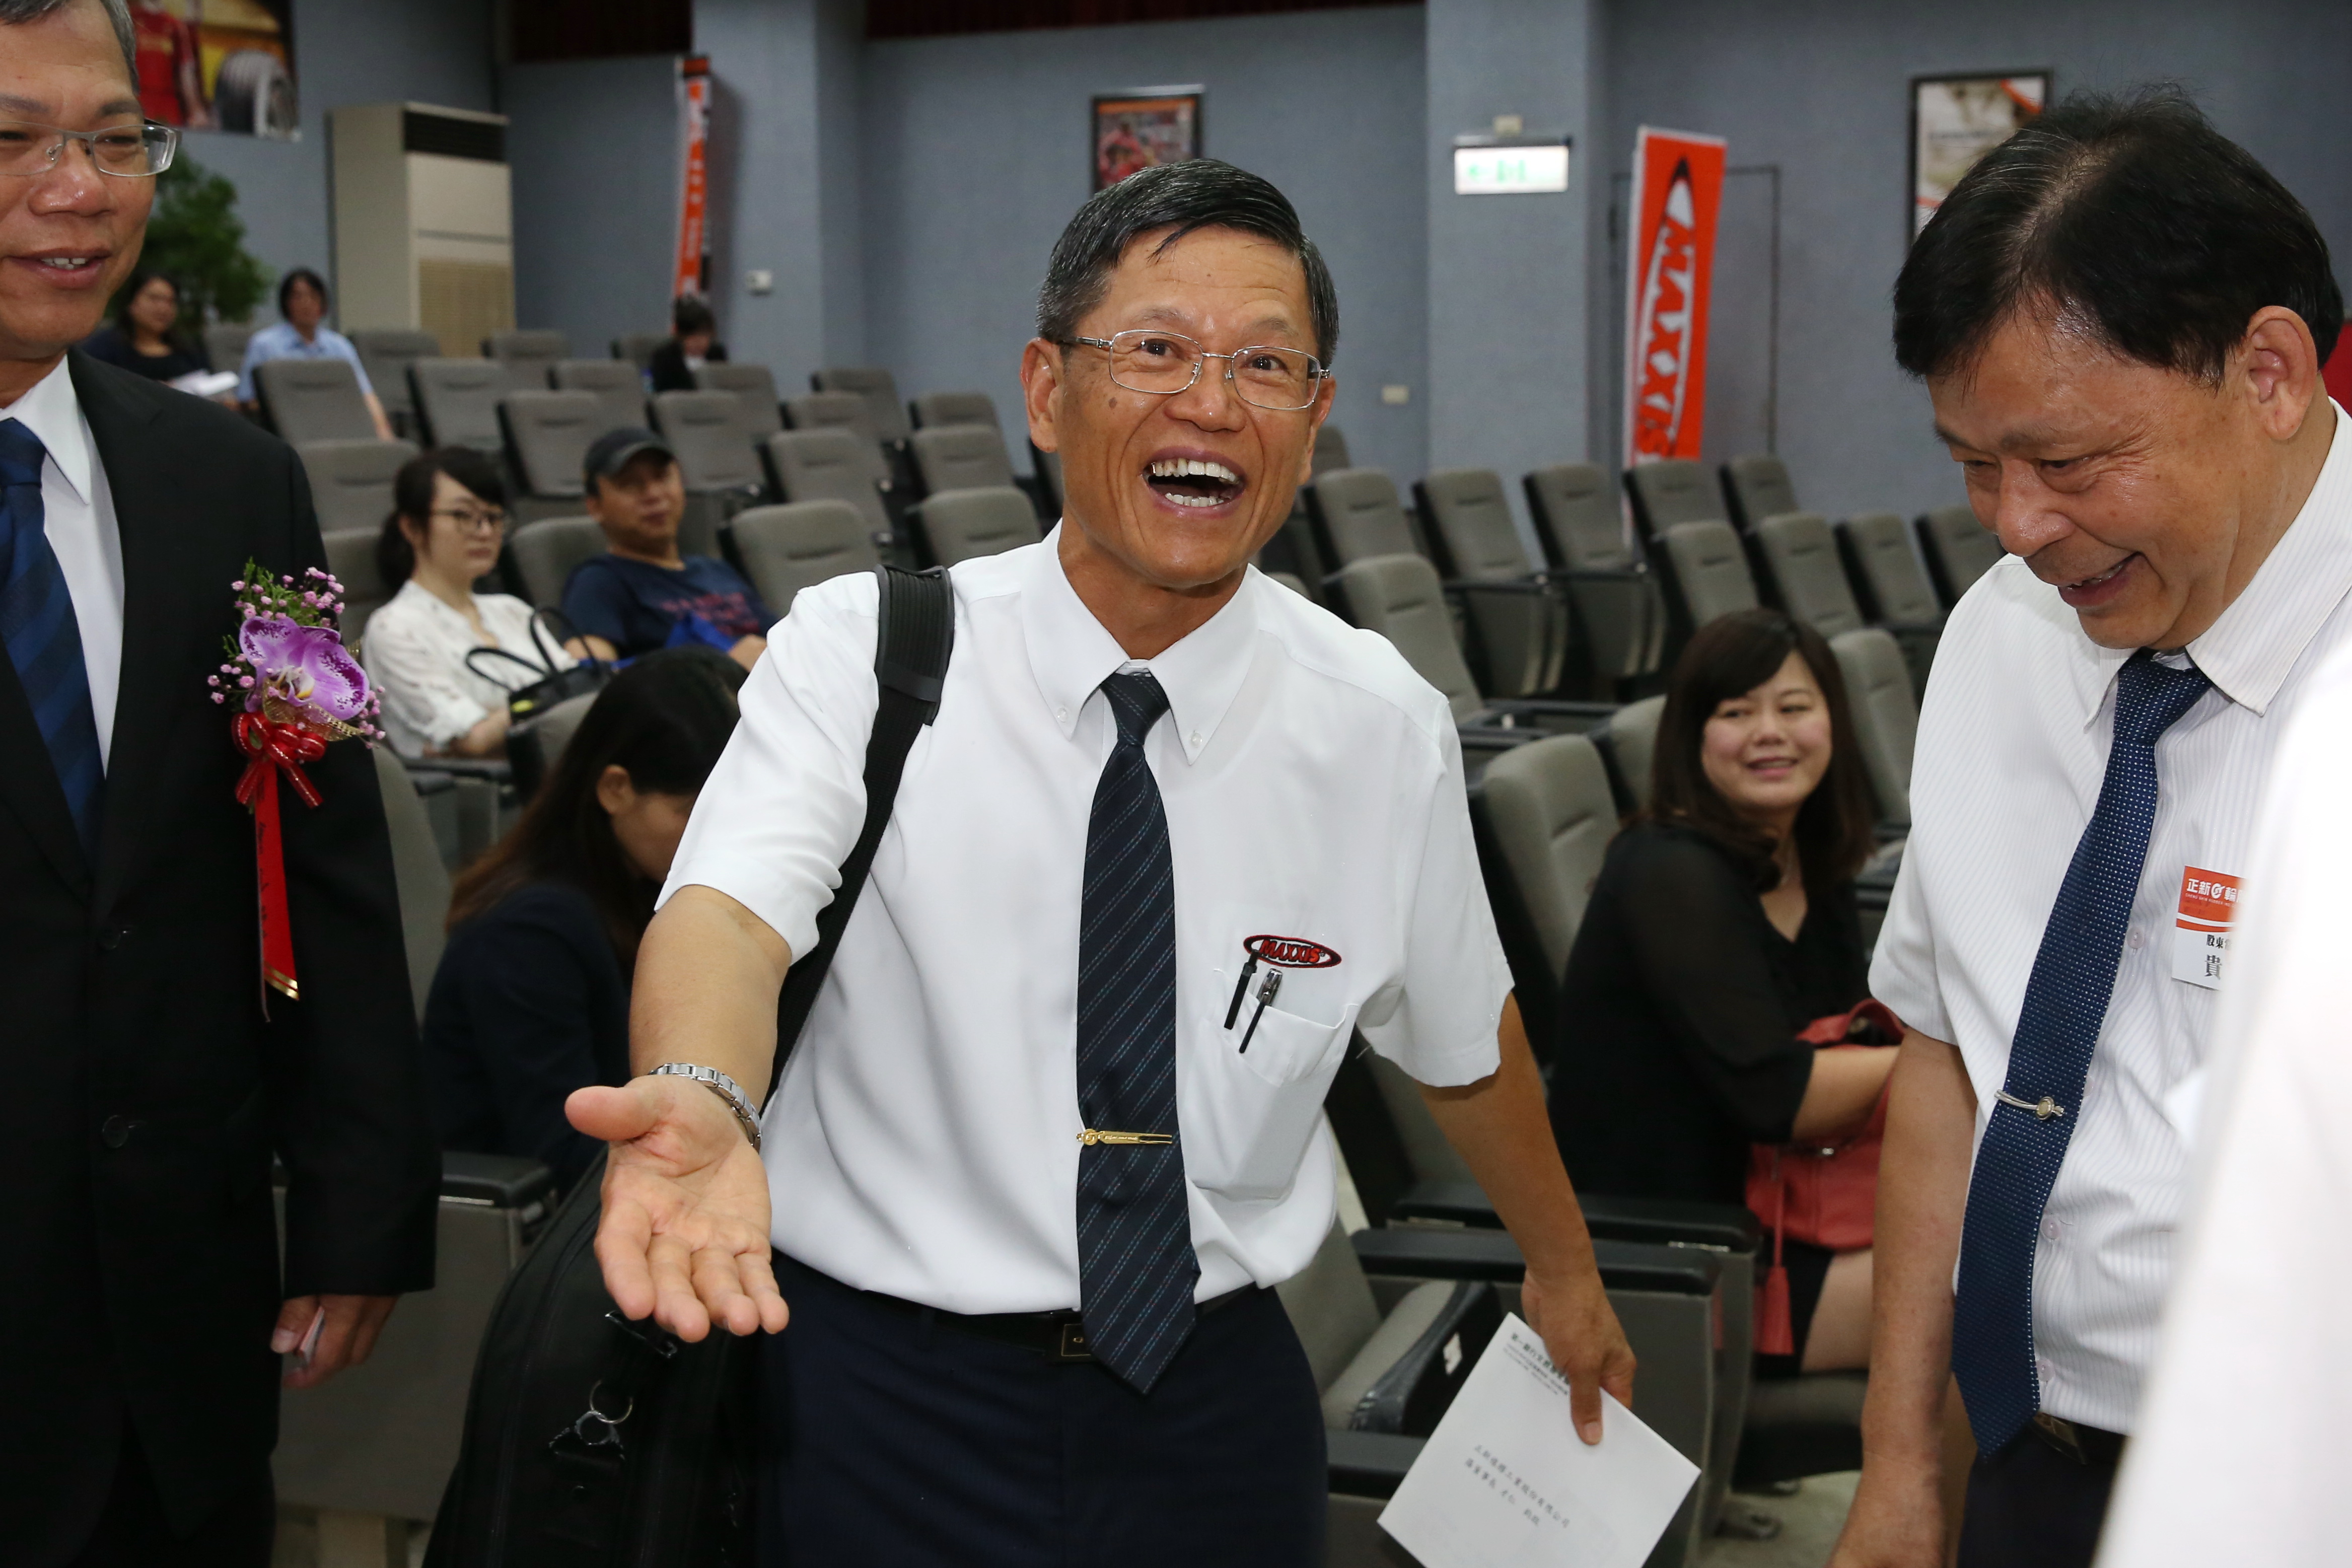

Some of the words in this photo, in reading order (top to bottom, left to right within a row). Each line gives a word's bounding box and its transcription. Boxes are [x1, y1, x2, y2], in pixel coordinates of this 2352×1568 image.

[1637, 216, 1693, 455] MAXXIS
[2186, 878, 2212, 896] 正新
[1260, 940, 1321, 963] MAXXIS
